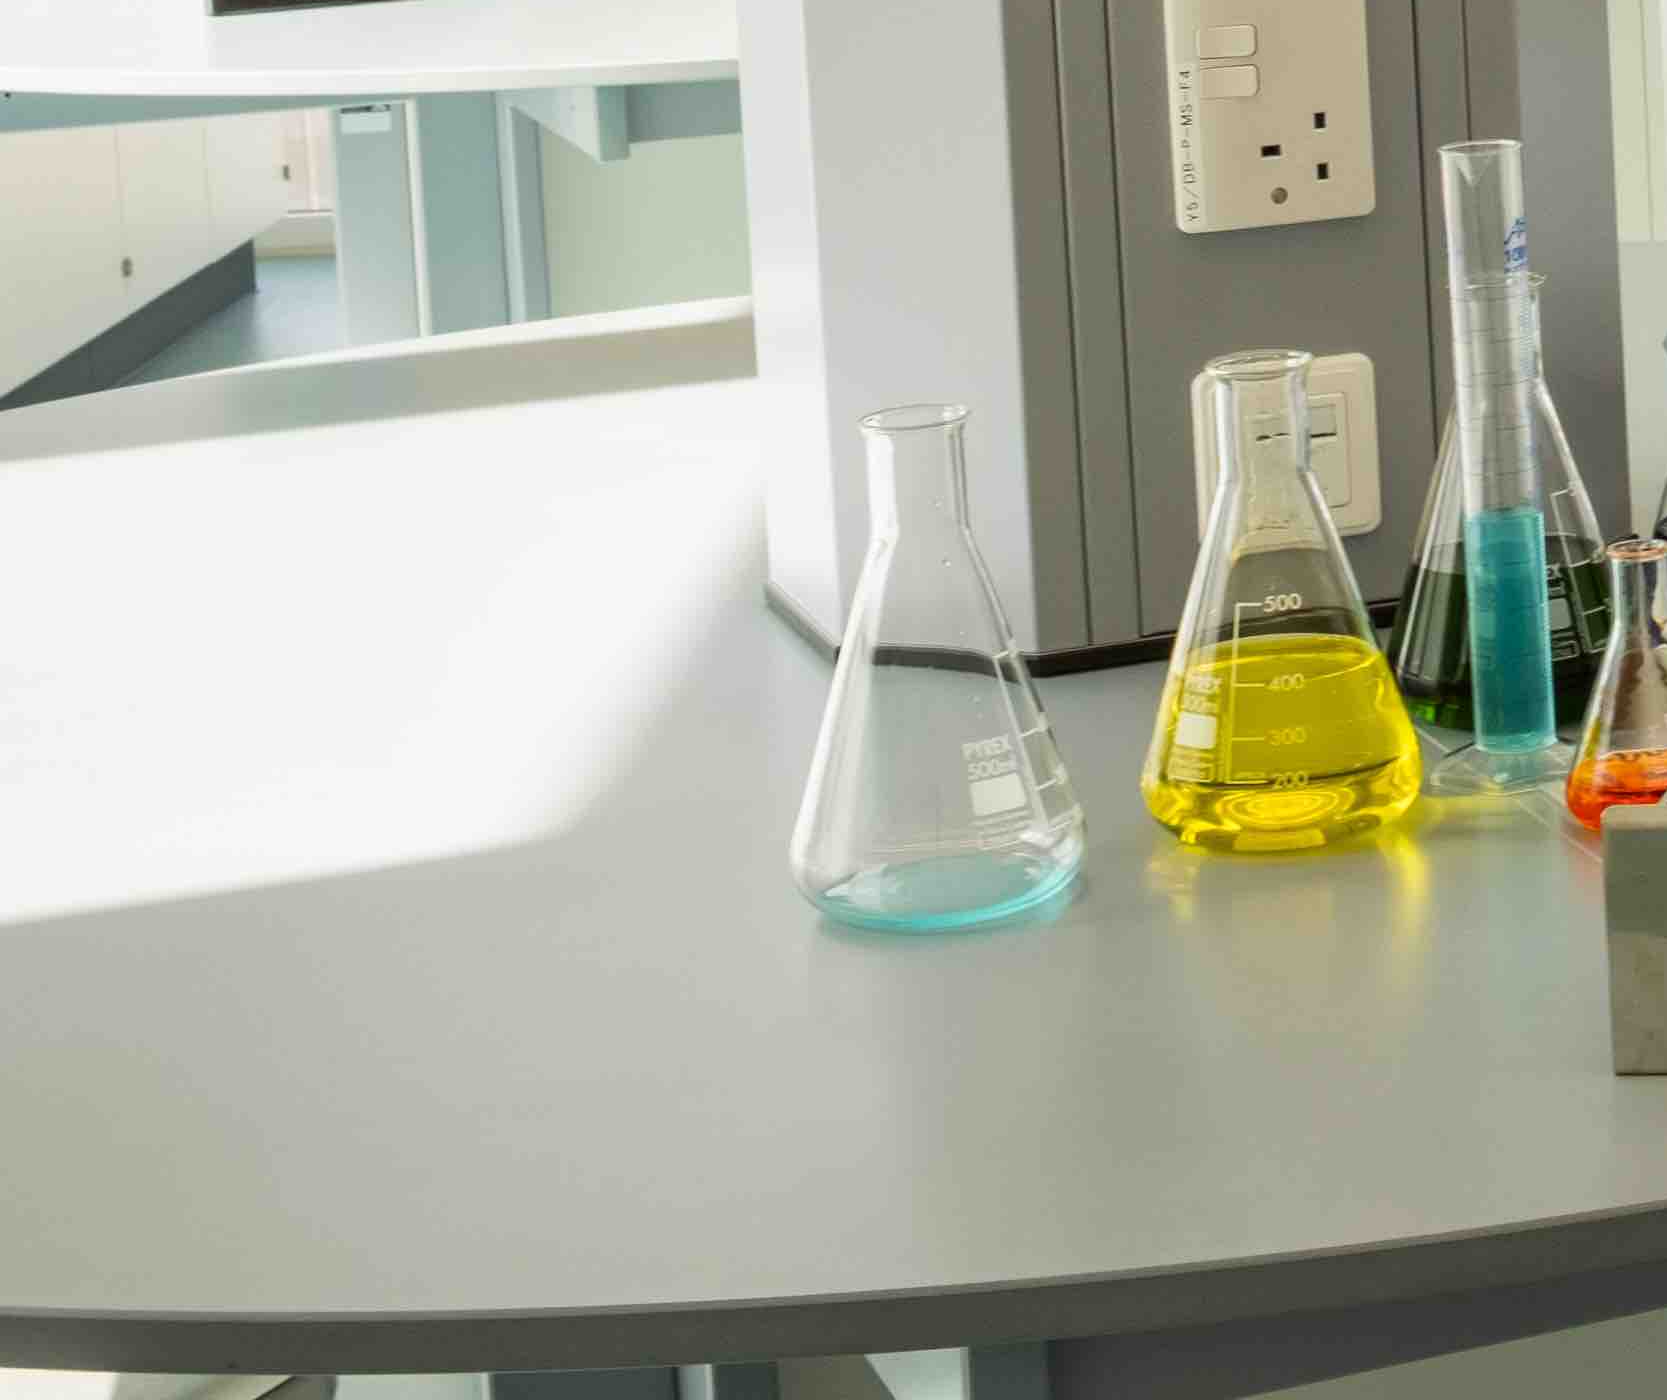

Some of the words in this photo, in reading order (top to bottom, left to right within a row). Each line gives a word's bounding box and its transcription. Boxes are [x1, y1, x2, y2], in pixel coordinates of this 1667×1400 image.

[1263, 593, 1301, 612] 500
[1268, 673, 1304, 692] 400
[1269, 727, 1306, 745] 300
[1274, 771, 1307, 789] 200
